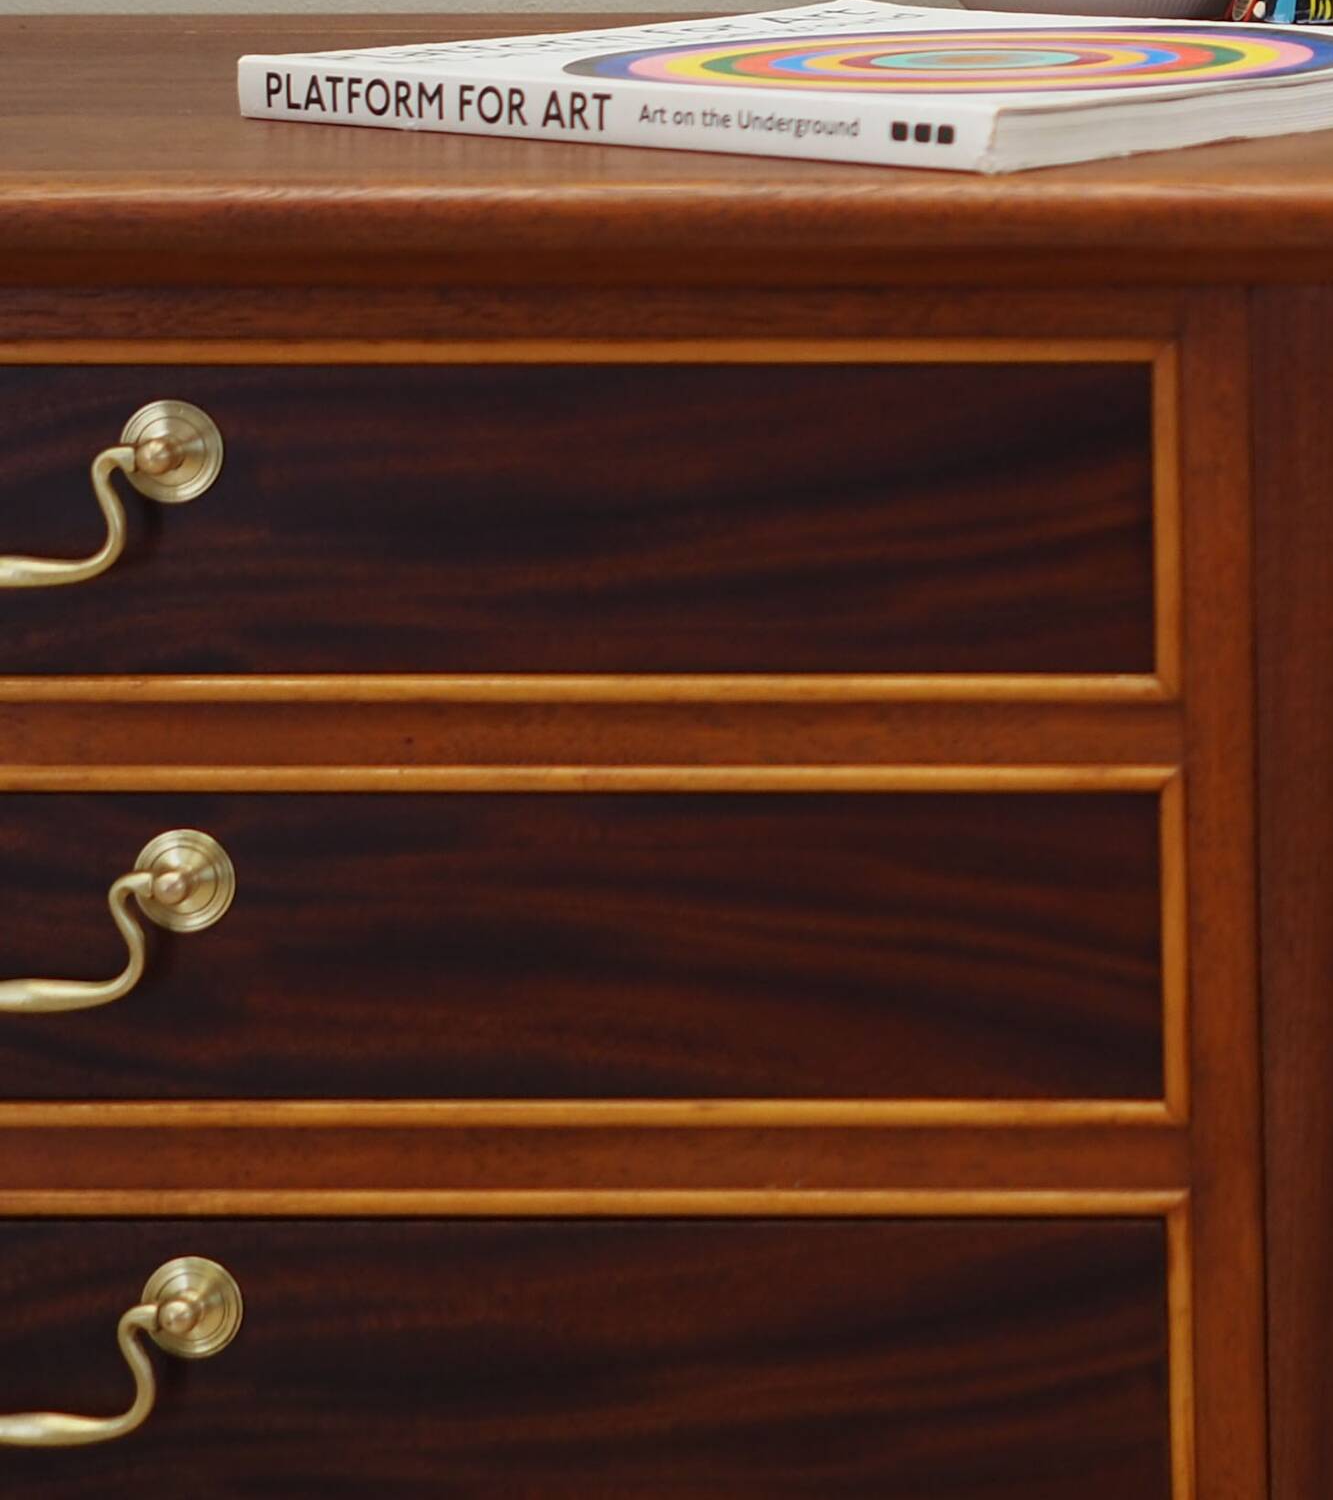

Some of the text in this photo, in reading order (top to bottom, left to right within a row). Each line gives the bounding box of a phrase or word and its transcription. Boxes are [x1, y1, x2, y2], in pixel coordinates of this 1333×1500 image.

[760, 7, 879, 25] Art
[266, 71, 613, 132] PLATFORM FOR ART
[639, 103, 861, 138] Art on the Underground
